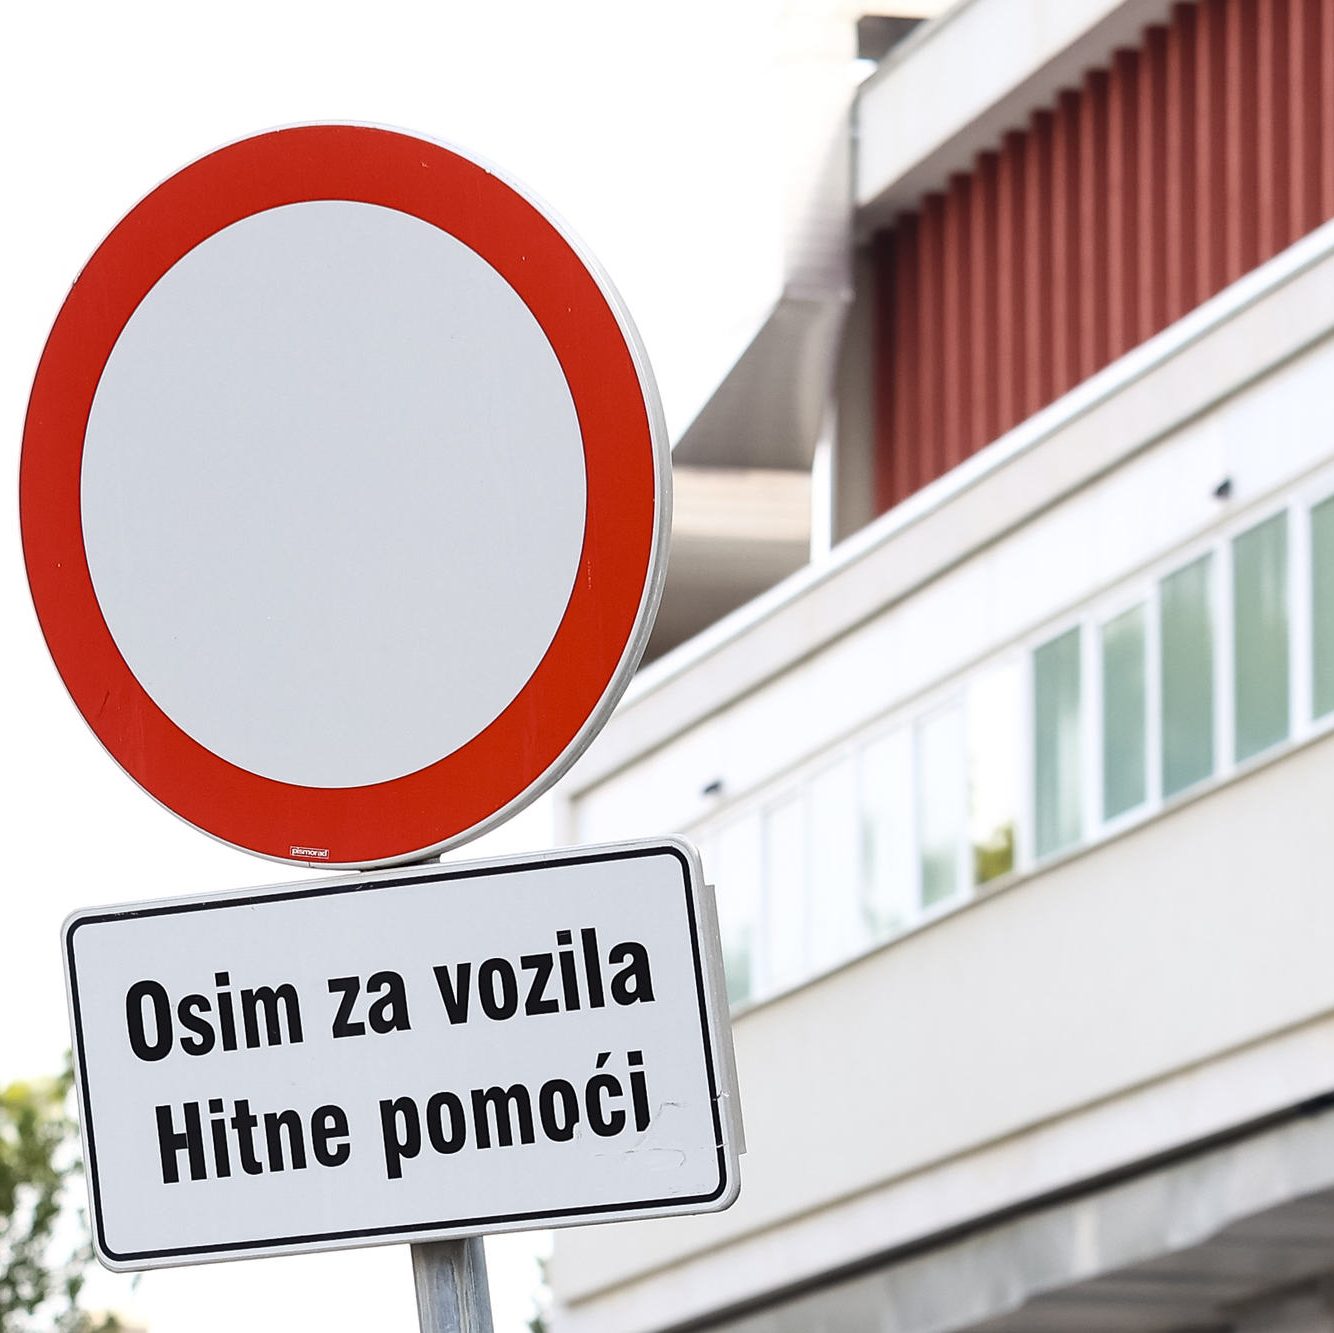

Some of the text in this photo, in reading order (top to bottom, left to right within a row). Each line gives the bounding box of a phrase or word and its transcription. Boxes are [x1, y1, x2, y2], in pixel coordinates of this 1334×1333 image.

[292, 848, 328, 857] pismorad
[124, 926, 657, 1063] Osim za vozila
[154, 1049, 652, 1185] Hitne pomoći
